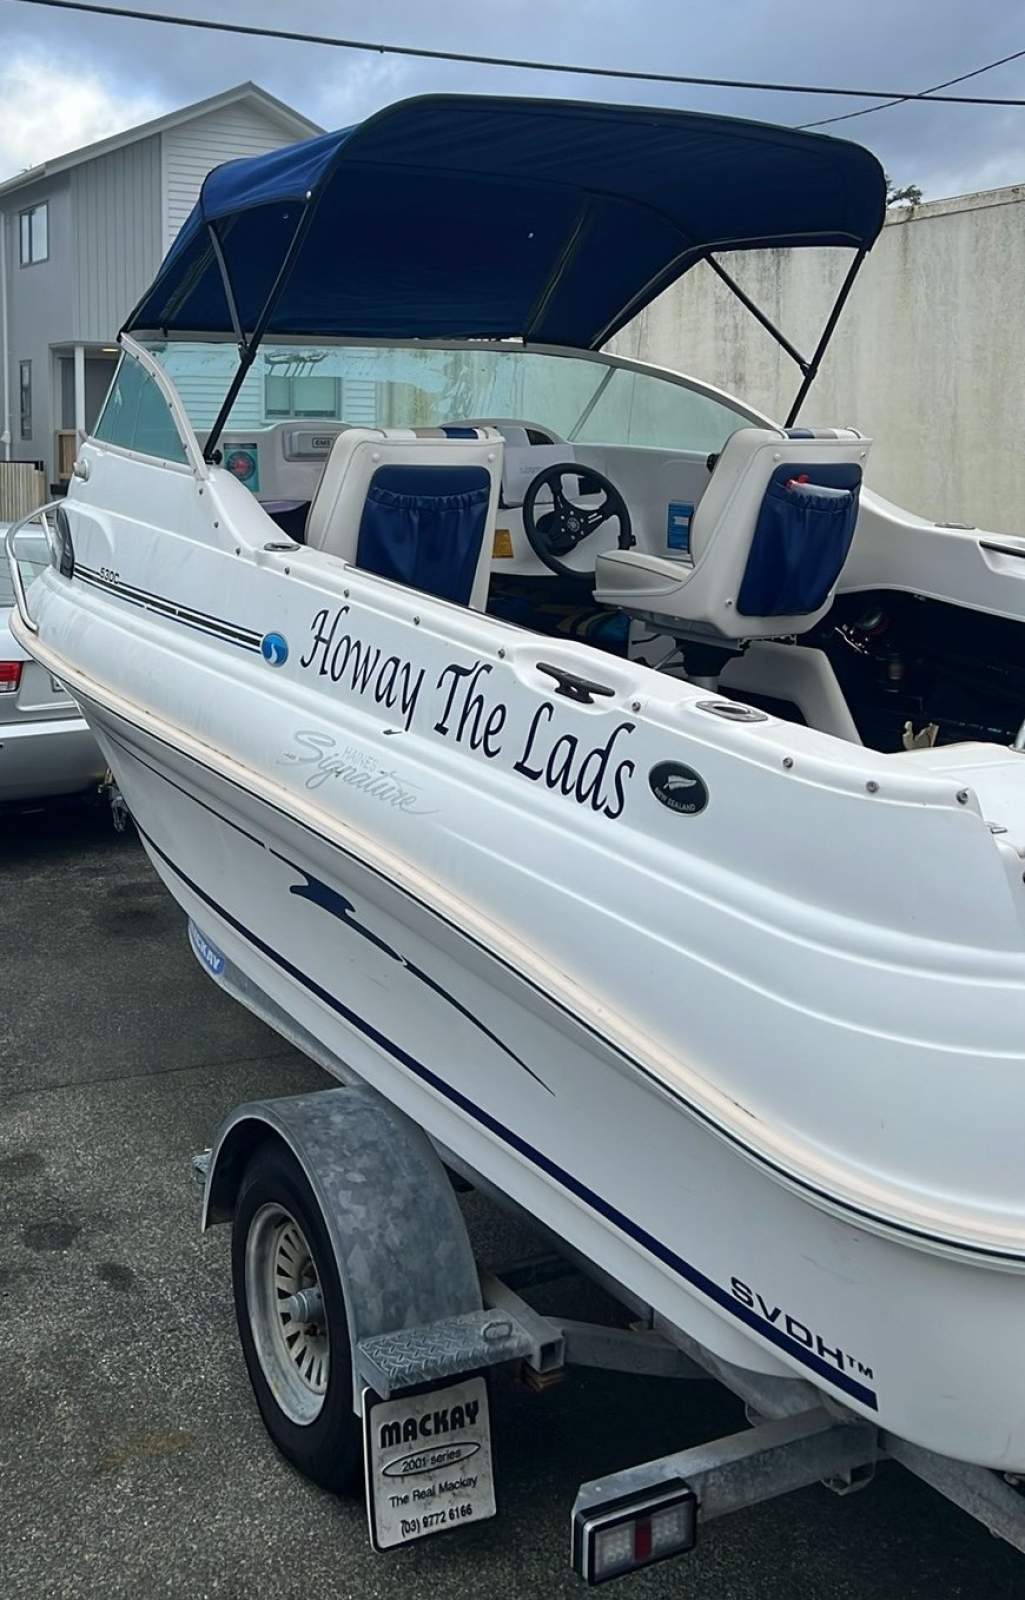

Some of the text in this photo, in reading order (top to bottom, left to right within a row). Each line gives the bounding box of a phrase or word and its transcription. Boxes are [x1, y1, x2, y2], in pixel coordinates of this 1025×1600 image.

[300, 605, 636, 819] Howay The Lads
[276, 730, 443, 815] Signature
[380, 1400, 480, 1448] MACKAY
[402, 1449, 462, 1472] 2001 series
[389, 1475, 478, 1508] The Real Mackay
[400, 1518, 420, 1538] (03)
[449, 1504, 473, 1520] 6166
